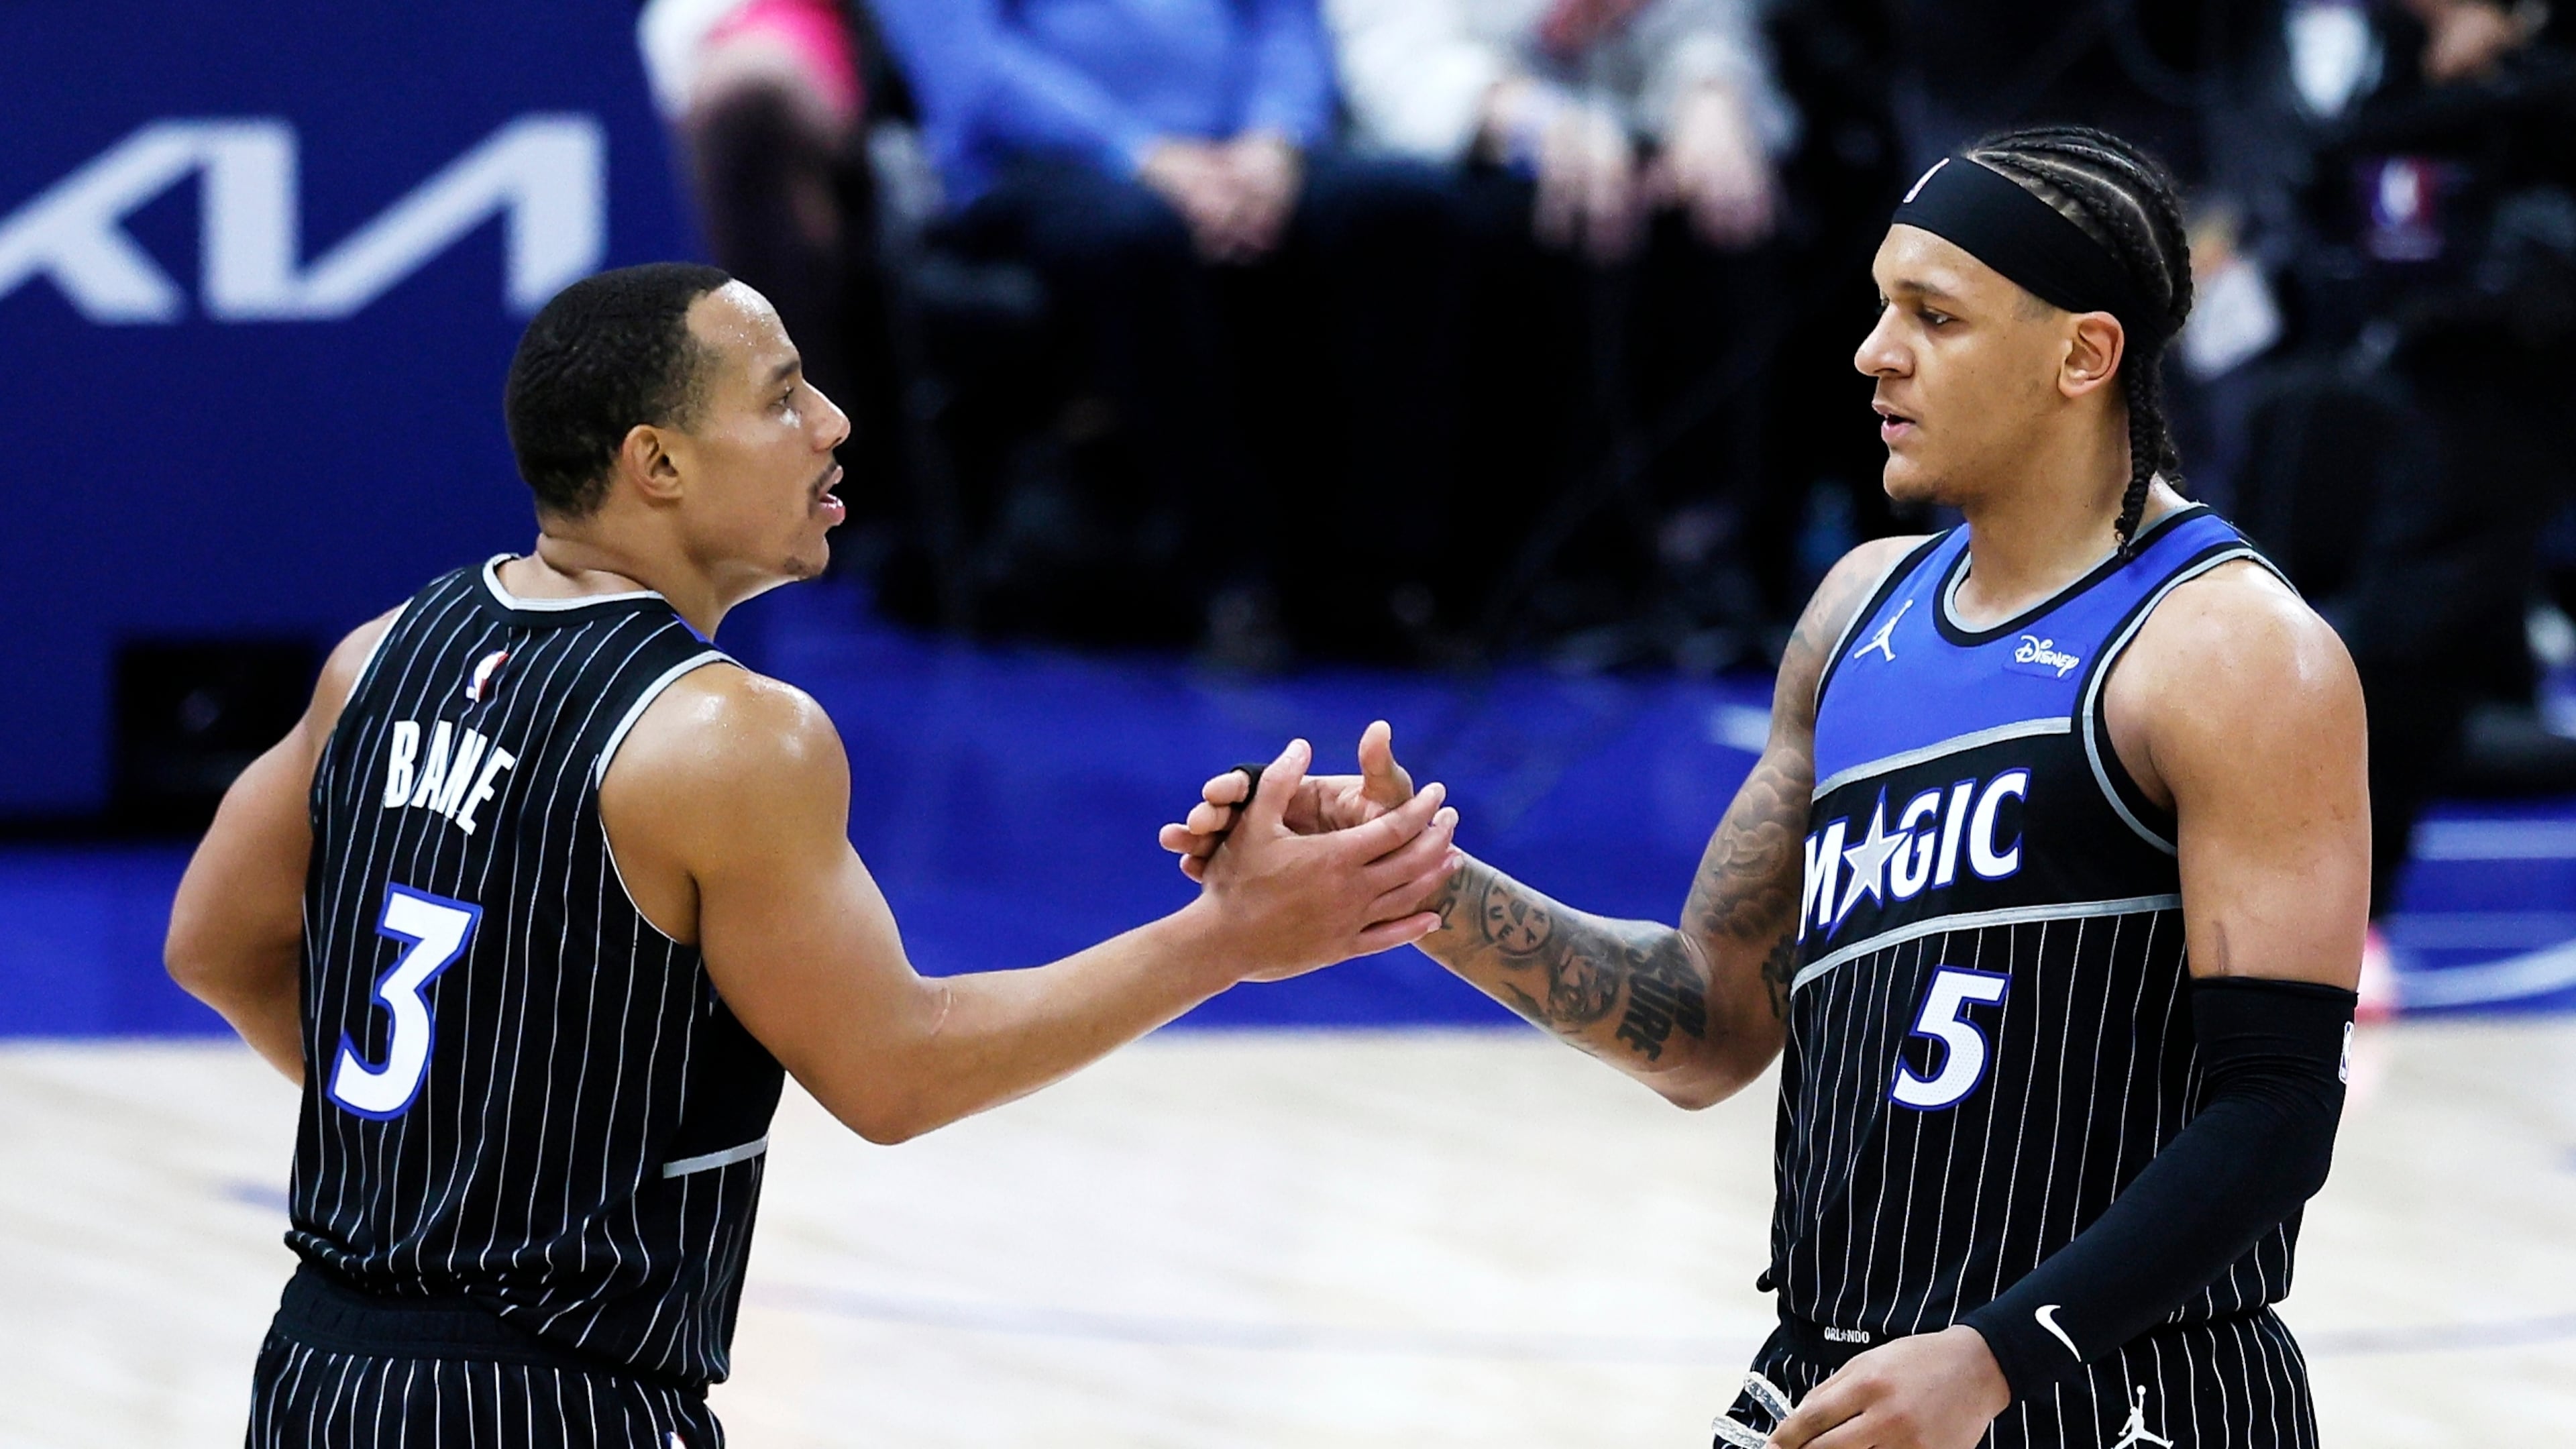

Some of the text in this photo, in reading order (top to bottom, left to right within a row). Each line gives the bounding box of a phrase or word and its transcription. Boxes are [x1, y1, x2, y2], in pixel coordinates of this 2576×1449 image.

[384, 720, 517, 836] BANE
[1797, 767, 2031, 945] MAGIC
[326, 881, 483, 1122] 3
[1887, 964, 2012, 1111] 5
